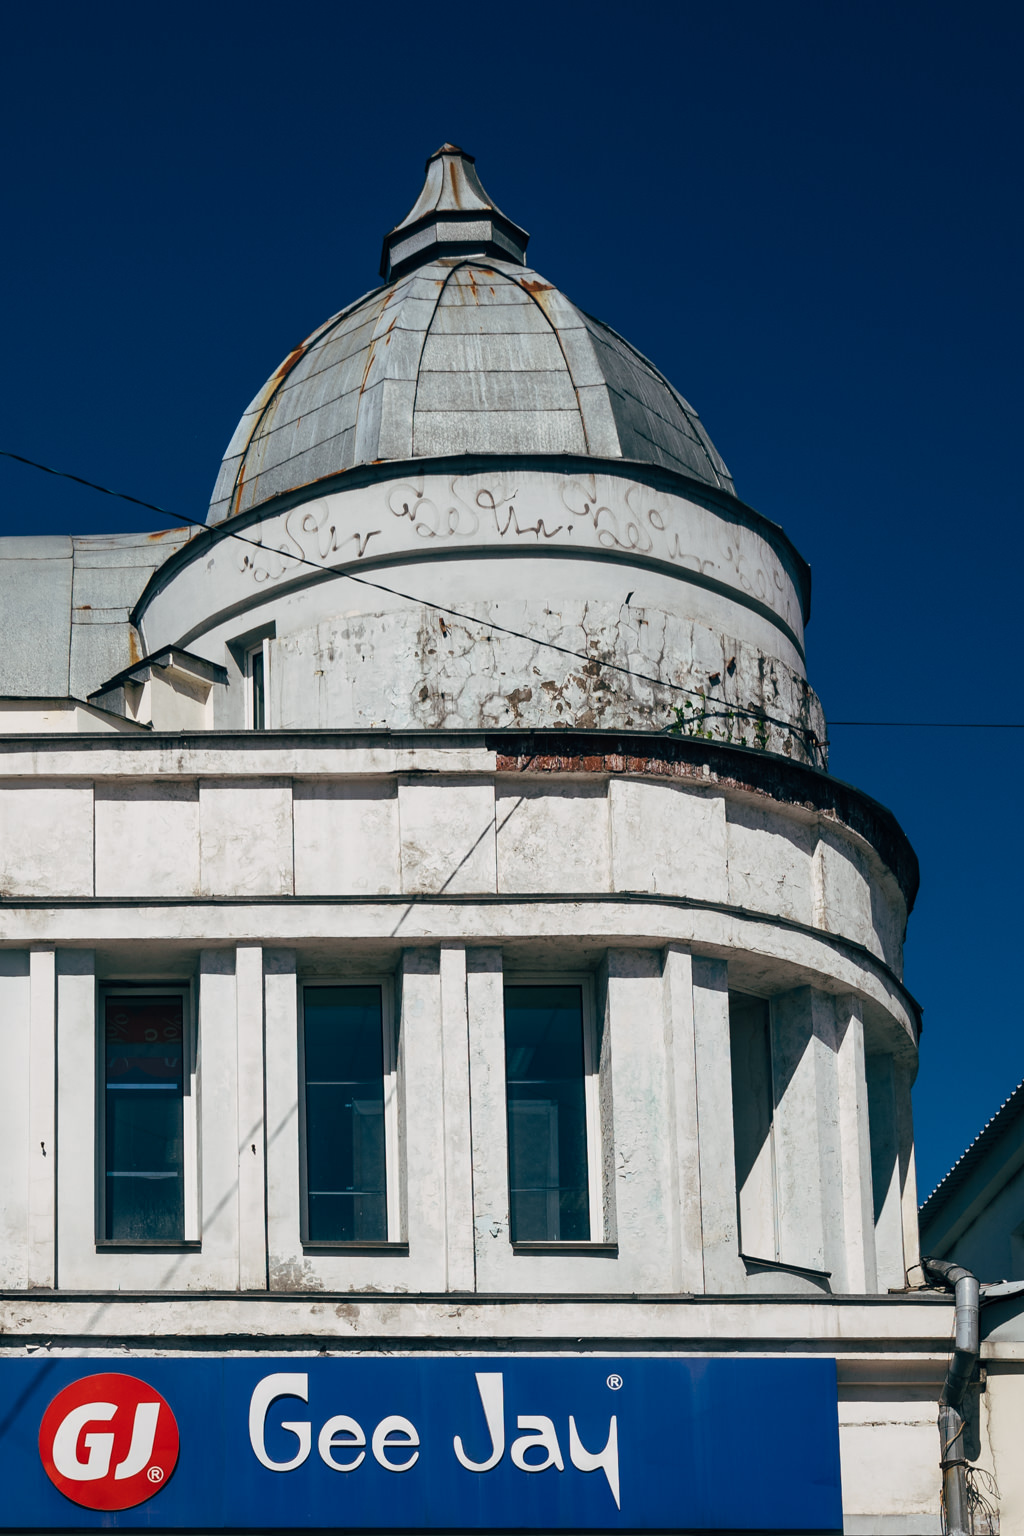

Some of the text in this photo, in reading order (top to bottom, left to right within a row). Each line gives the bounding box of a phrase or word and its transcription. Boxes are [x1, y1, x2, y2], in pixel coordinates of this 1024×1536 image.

[52, 1401, 162, 1482] GJ
[249, 1372, 622, 1511] Gee Jay
